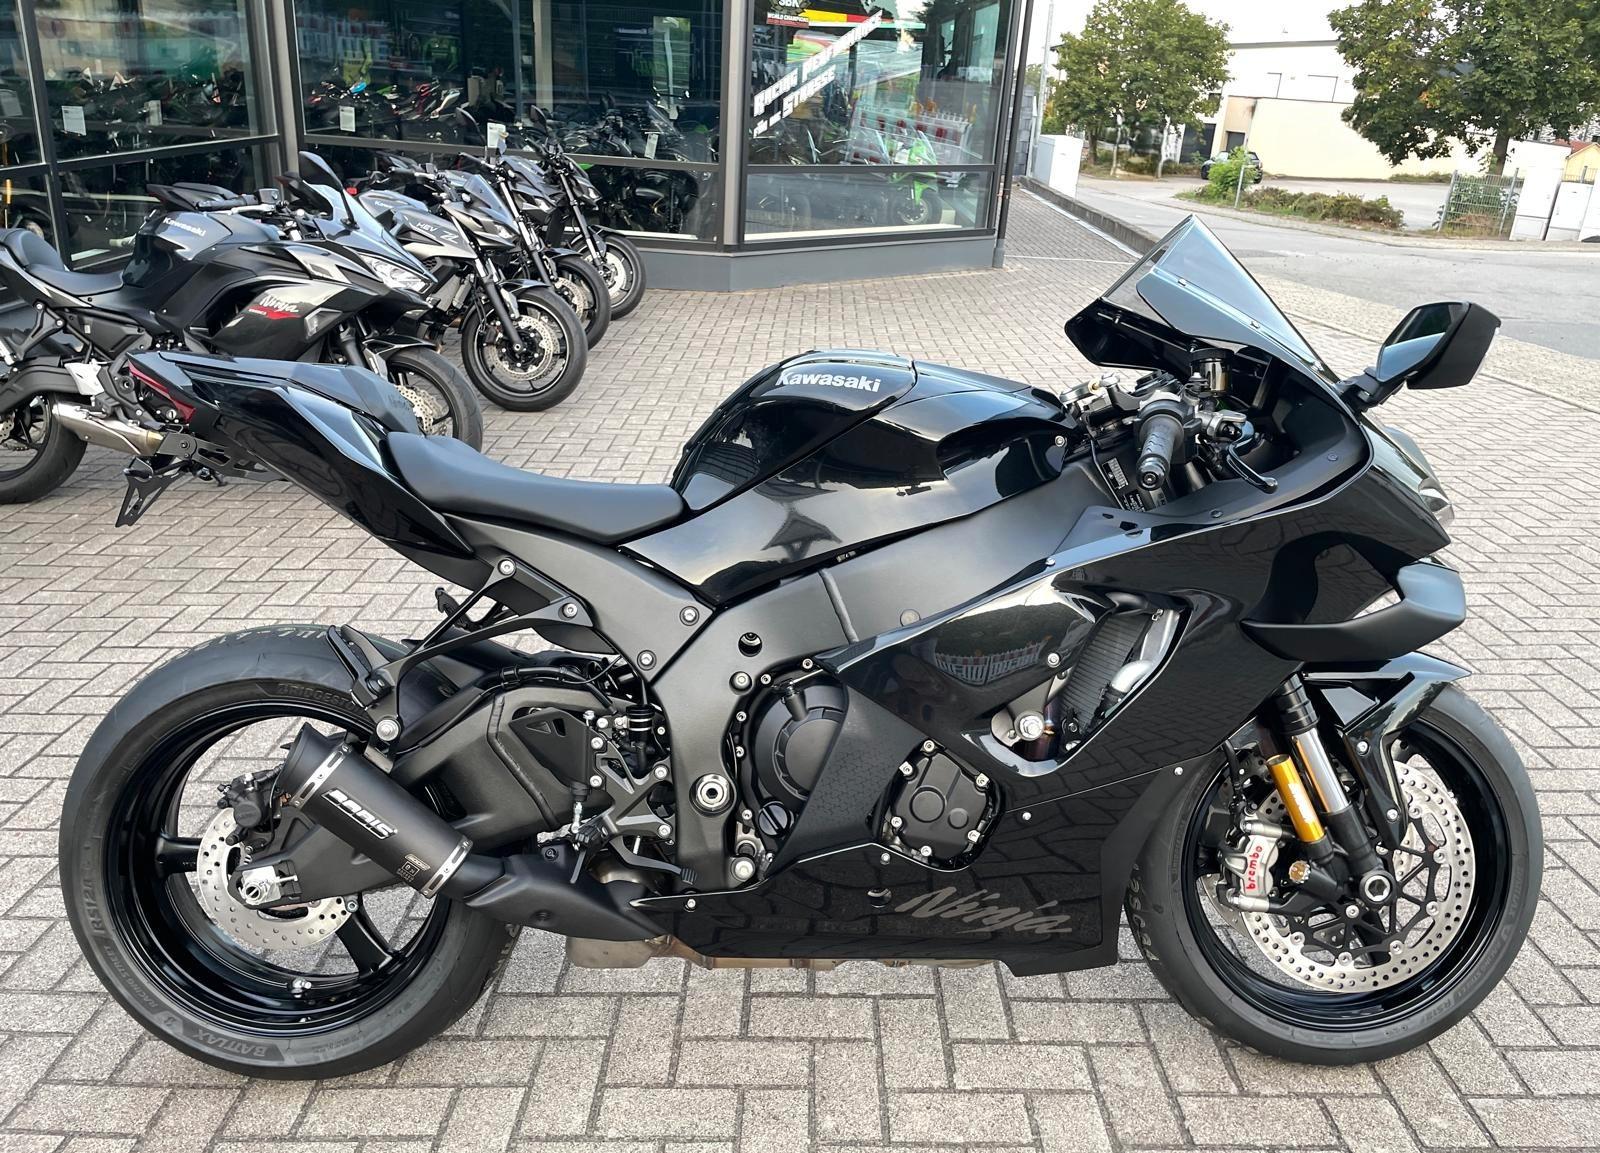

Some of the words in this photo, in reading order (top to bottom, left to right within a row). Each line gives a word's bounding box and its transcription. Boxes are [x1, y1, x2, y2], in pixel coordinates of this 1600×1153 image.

[753, 68, 798, 117] RACING
[162, 217, 207, 237] Kawasaki
[259, 294, 300, 313] Ninja
[775, 371, 881, 393] Kawasaki
[279, 683, 364, 715] BRIDGESTO
[1245, 845, 1263, 891] brembo
[894, 886, 1072, 934] Ninja
[197, 1029, 267, 1057] BATTLAX
